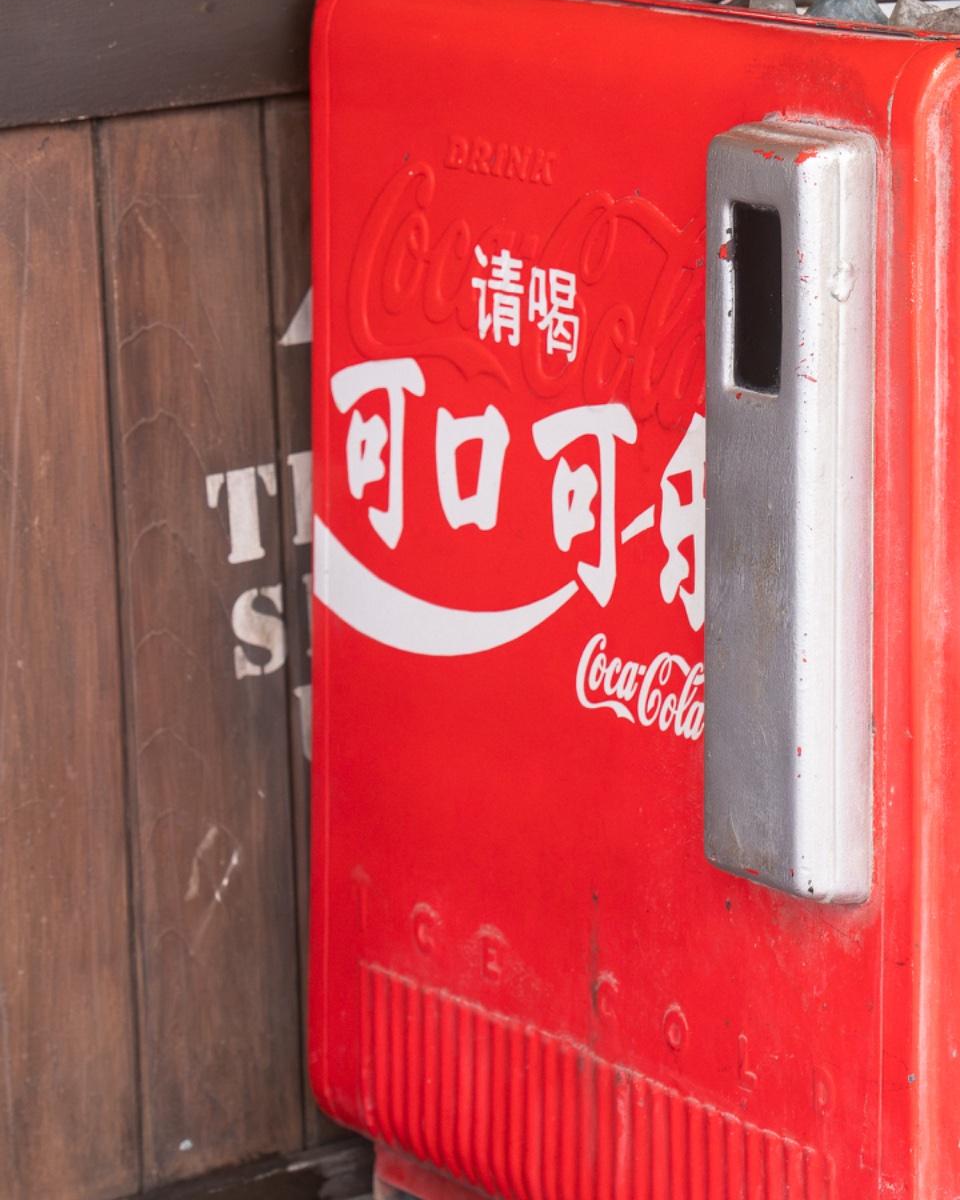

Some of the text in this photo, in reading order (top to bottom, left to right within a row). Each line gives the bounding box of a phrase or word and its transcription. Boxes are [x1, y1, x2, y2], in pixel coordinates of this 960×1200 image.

[444, 134, 558, 185] DRINK
[471, 244, 581, 363] 请喝
[575, 632, 705, 741] Coca-Cola
